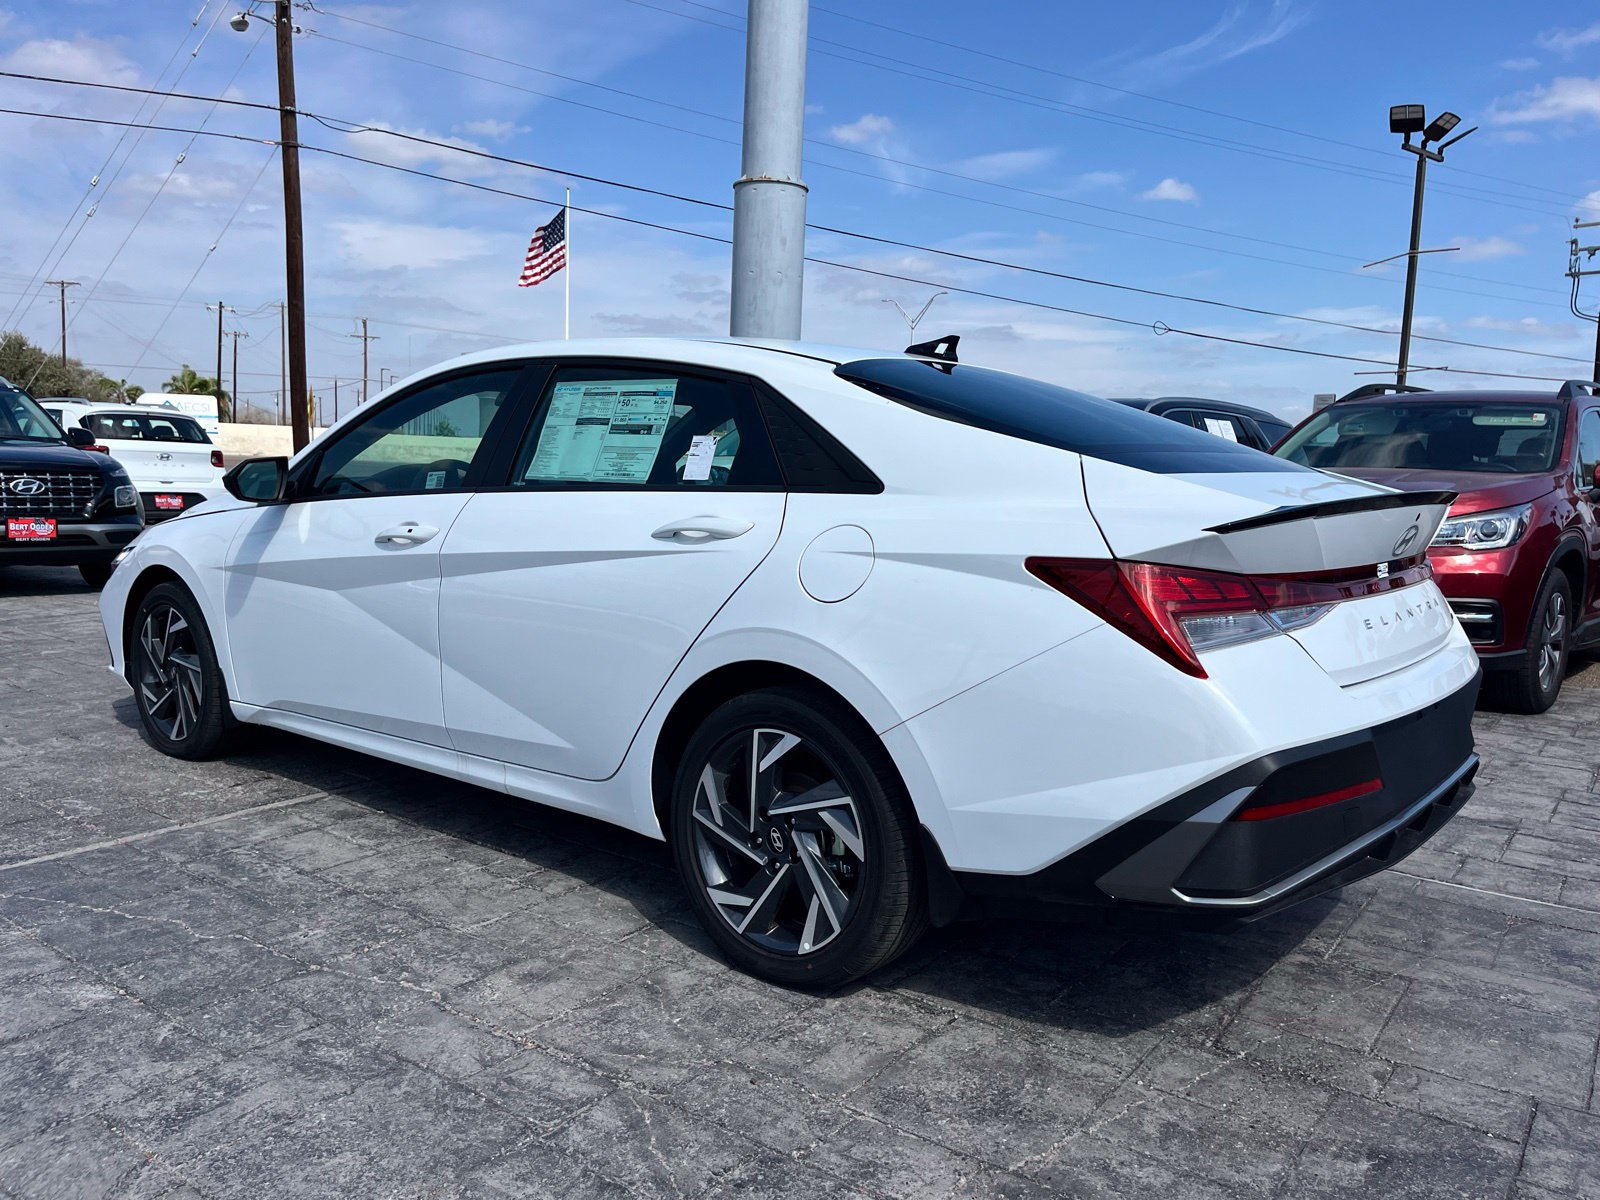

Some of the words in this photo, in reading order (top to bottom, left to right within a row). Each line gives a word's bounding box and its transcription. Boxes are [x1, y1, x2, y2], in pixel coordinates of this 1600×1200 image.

[621, 399, 631, 407] 50
[9, 522, 28, 530] BERT
[30, 522, 54, 530] OGDEN
[1362, 597, 1440, 631] ELANTRA
